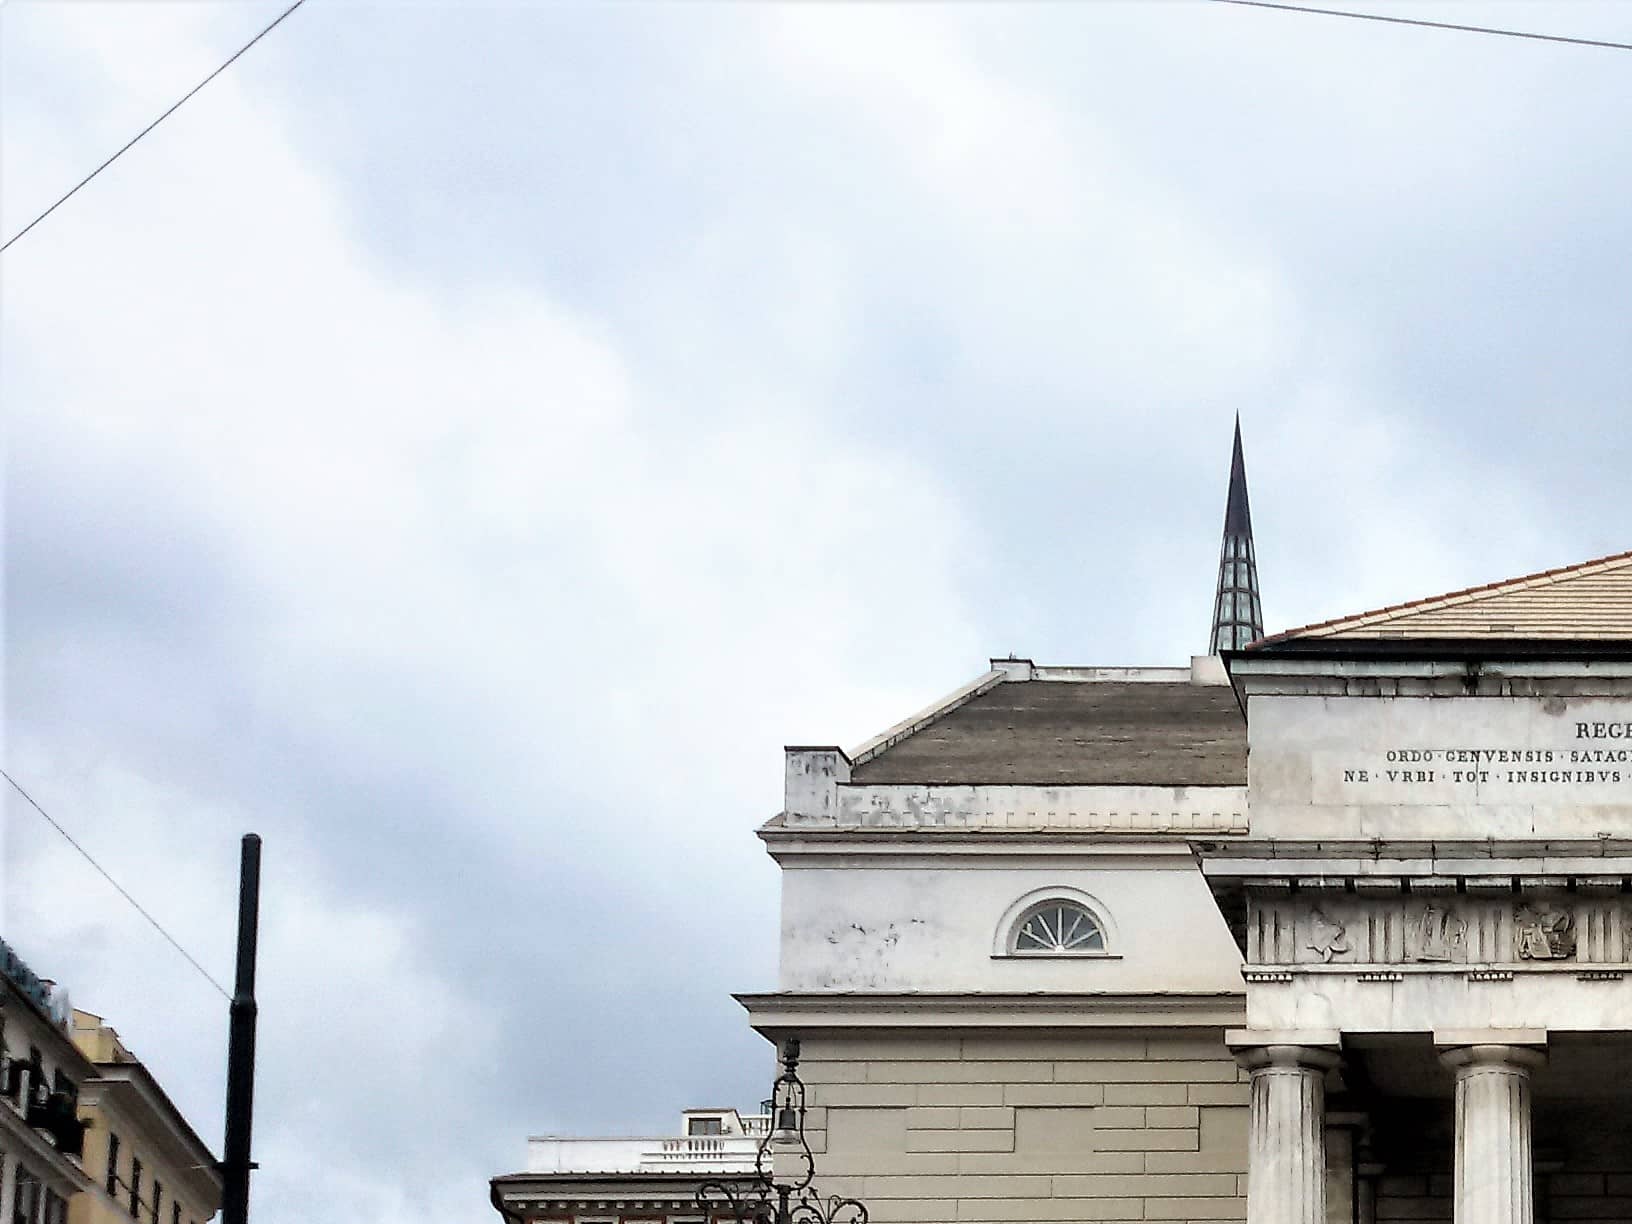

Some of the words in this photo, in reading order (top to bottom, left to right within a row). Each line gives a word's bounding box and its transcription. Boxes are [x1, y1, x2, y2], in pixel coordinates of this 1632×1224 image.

[1386, 750, 1433, 763] ORDO
[1445, 750, 1553, 763] GENVENSIS
[1343, 770, 1370, 783] NE
[1386, 770, 1435, 783] VRBI
[1452, 770, 1489, 783] TOT
[1507, 770, 1621, 783] INSIGNIBVS
